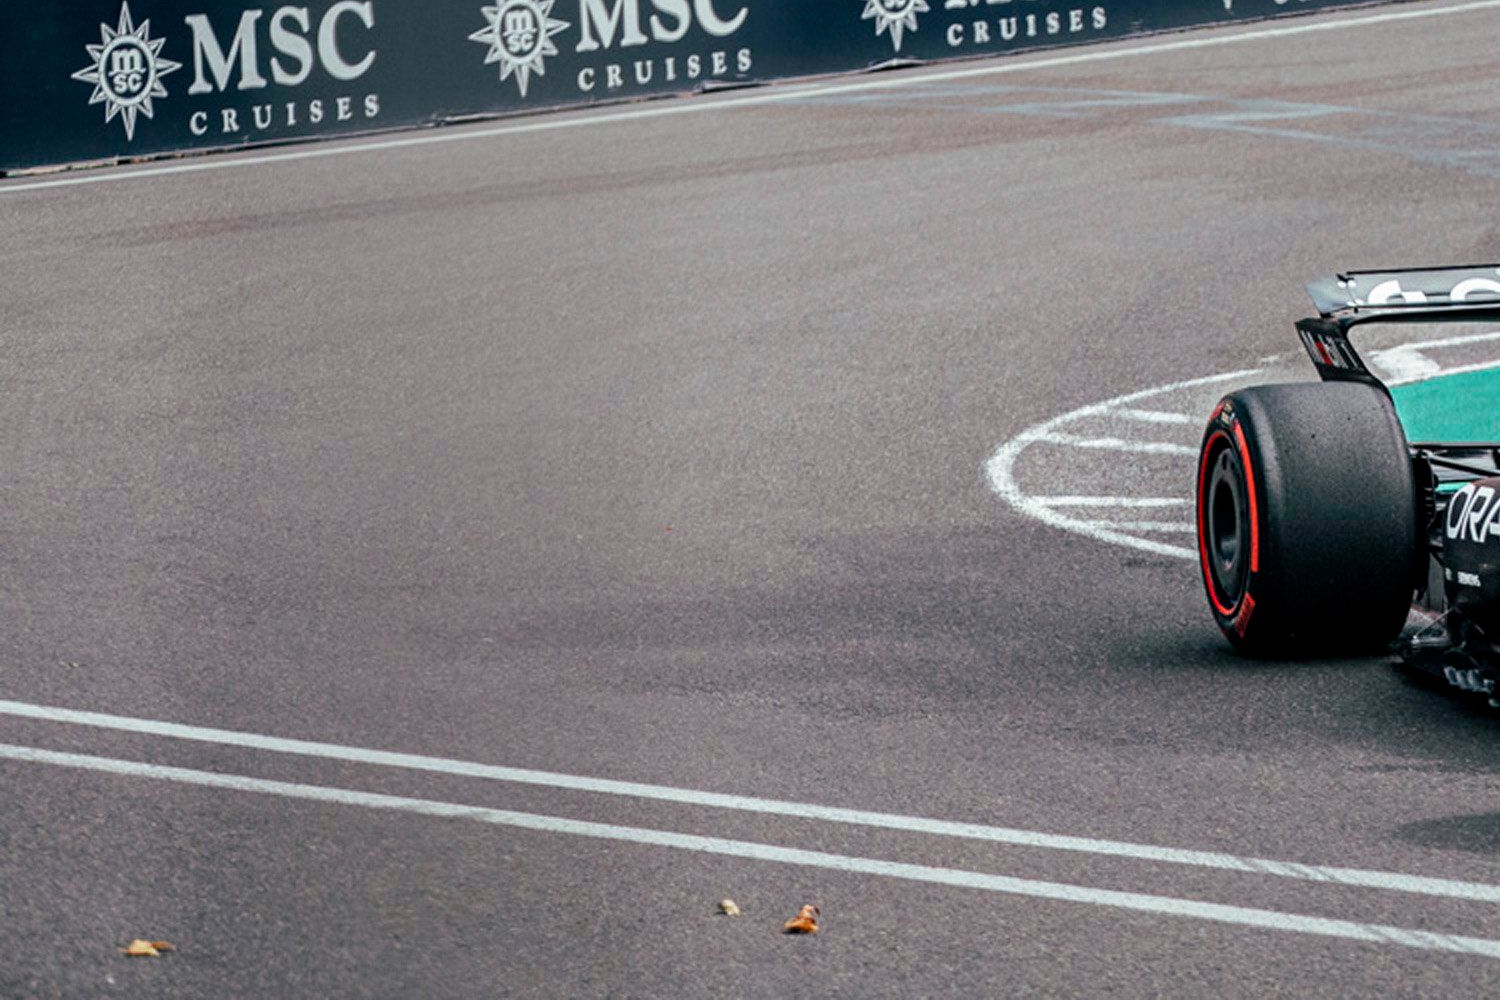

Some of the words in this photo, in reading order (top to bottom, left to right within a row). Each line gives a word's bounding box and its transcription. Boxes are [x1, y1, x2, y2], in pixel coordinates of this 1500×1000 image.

[185, 1, 376, 94] MSC
[946, 7, 1107, 47] CRUISES
[577, 48, 752, 92] CRUISES
[190, 94, 380, 136] CRUISES
